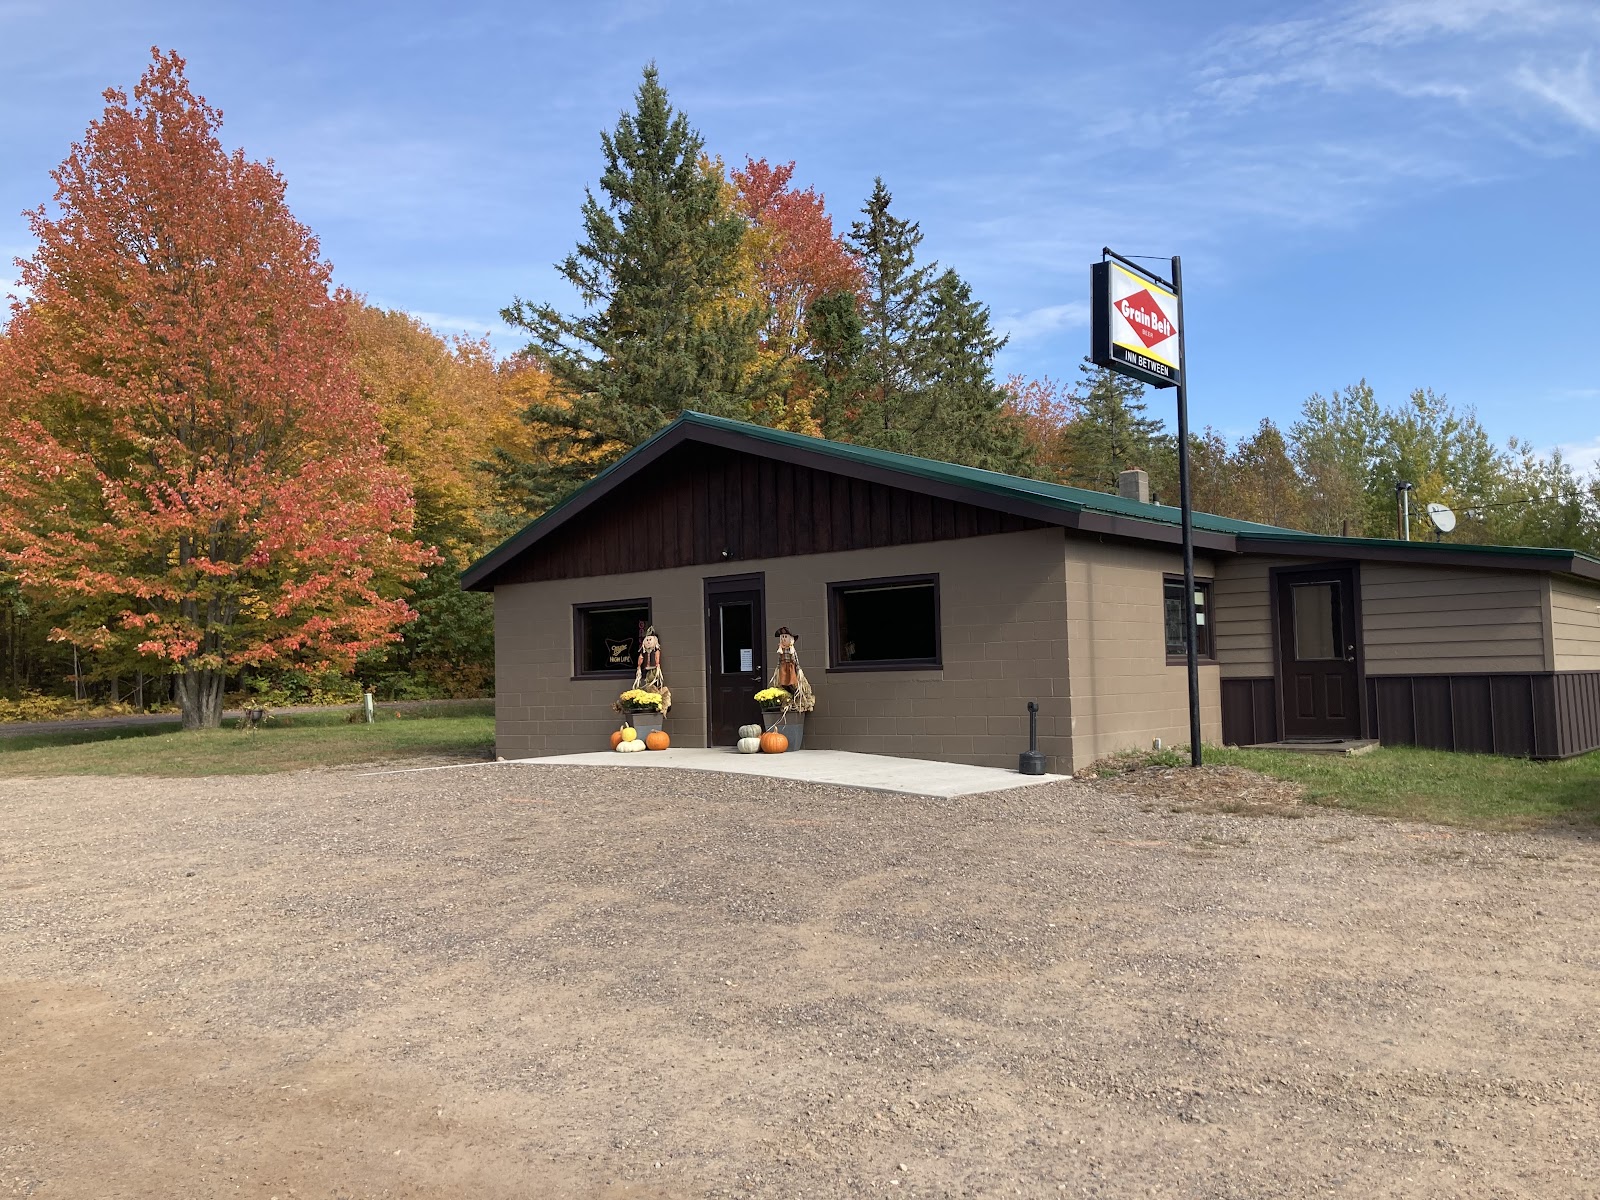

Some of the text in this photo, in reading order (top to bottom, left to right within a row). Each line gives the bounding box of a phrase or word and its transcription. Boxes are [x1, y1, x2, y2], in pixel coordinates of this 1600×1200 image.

[1121, 299, 1171, 336] Grain Belt
[1125, 350, 1169, 377] INN BETWEEN
